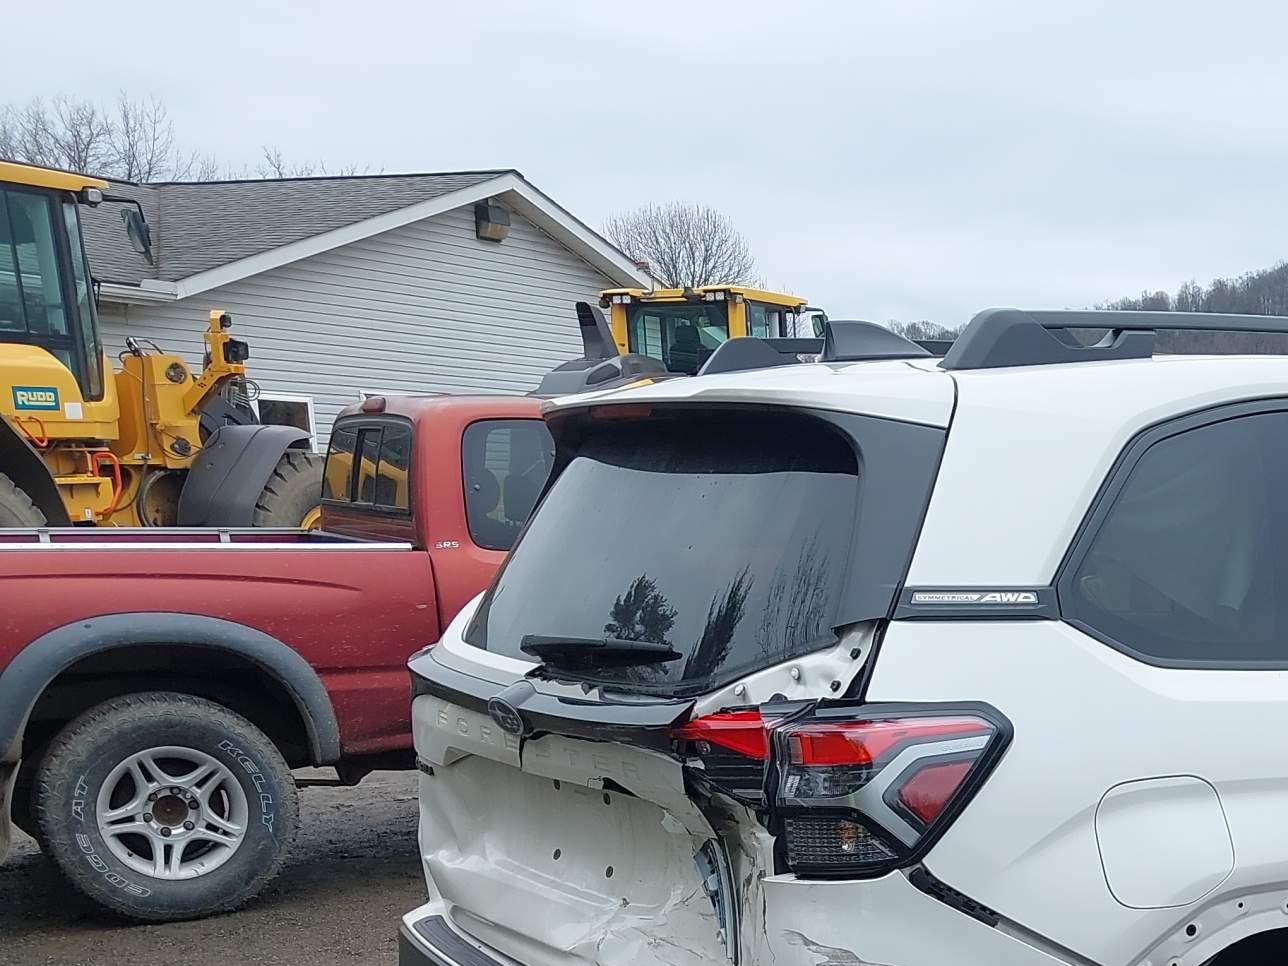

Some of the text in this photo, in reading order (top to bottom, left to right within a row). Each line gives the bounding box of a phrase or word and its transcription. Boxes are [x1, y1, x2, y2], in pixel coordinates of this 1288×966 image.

[16, 391, 56, 406] RUDD
[981, 592, 1037, 602] AWD
[437, 709, 641, 779] FORESTER
[218, 740, 275, 833] KELLY
[72, 776, 152, 898] EDGE AT
